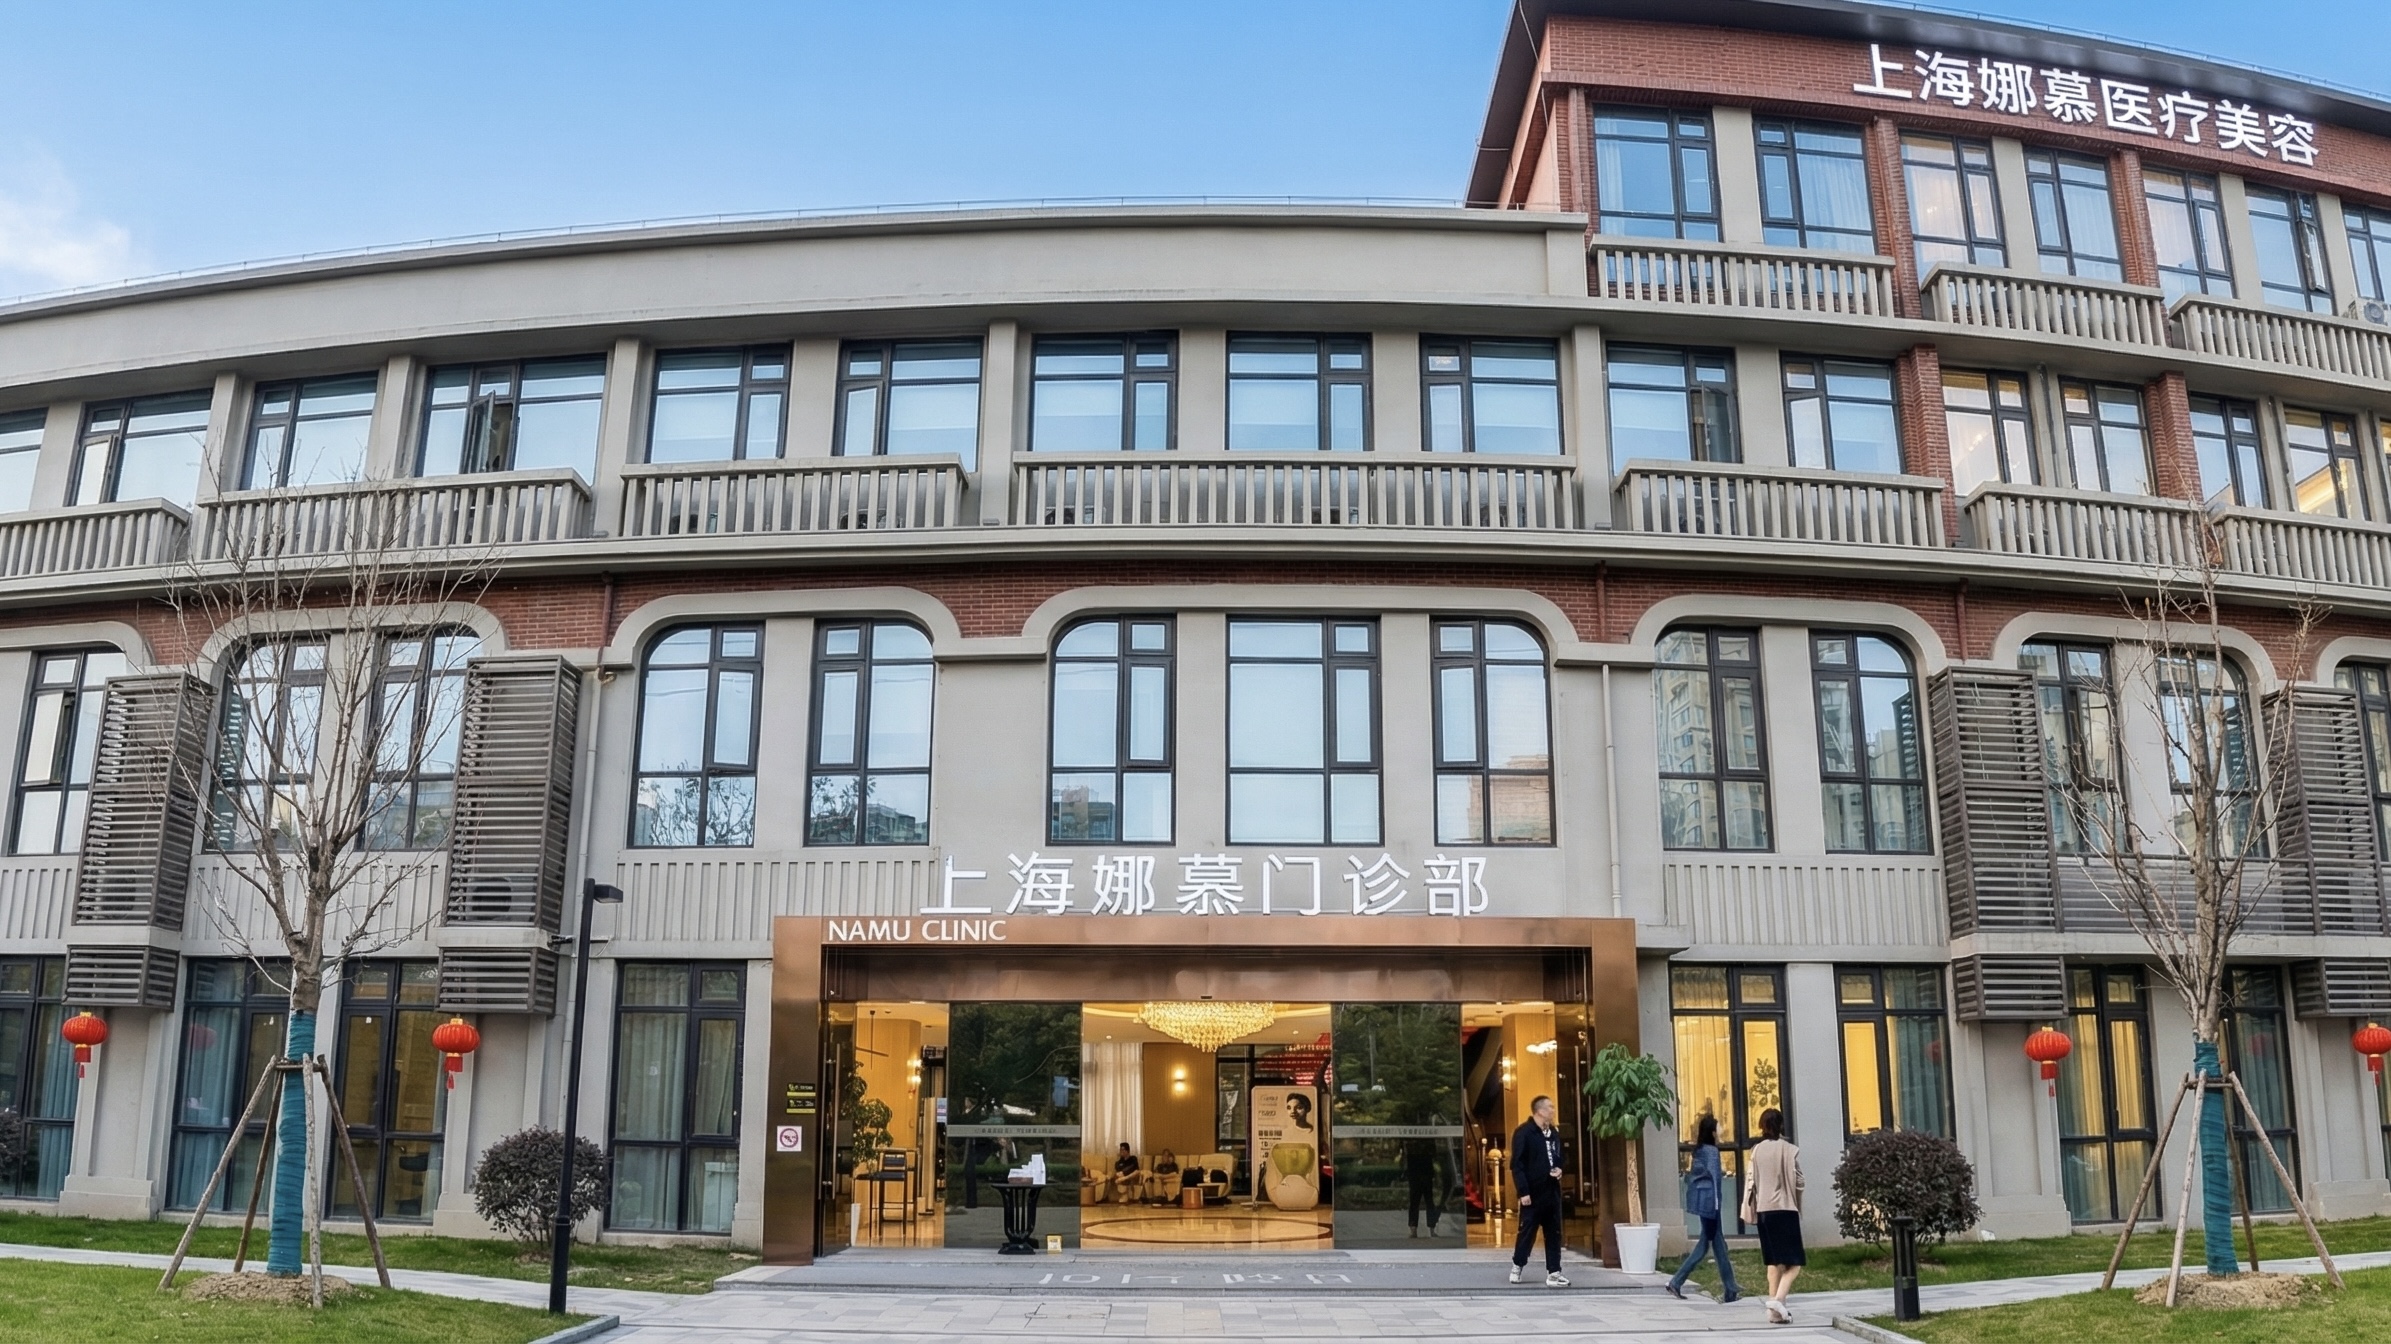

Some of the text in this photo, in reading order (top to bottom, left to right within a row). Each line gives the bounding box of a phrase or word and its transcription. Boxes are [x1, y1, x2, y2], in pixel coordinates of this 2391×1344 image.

[1853, 43, 2319, 167] 上海娜慕医疗美容
[920, 851, 1489, 916] 上海娜慕门诊部
[828, 919, 1007, 942] NAMU CLINIC
